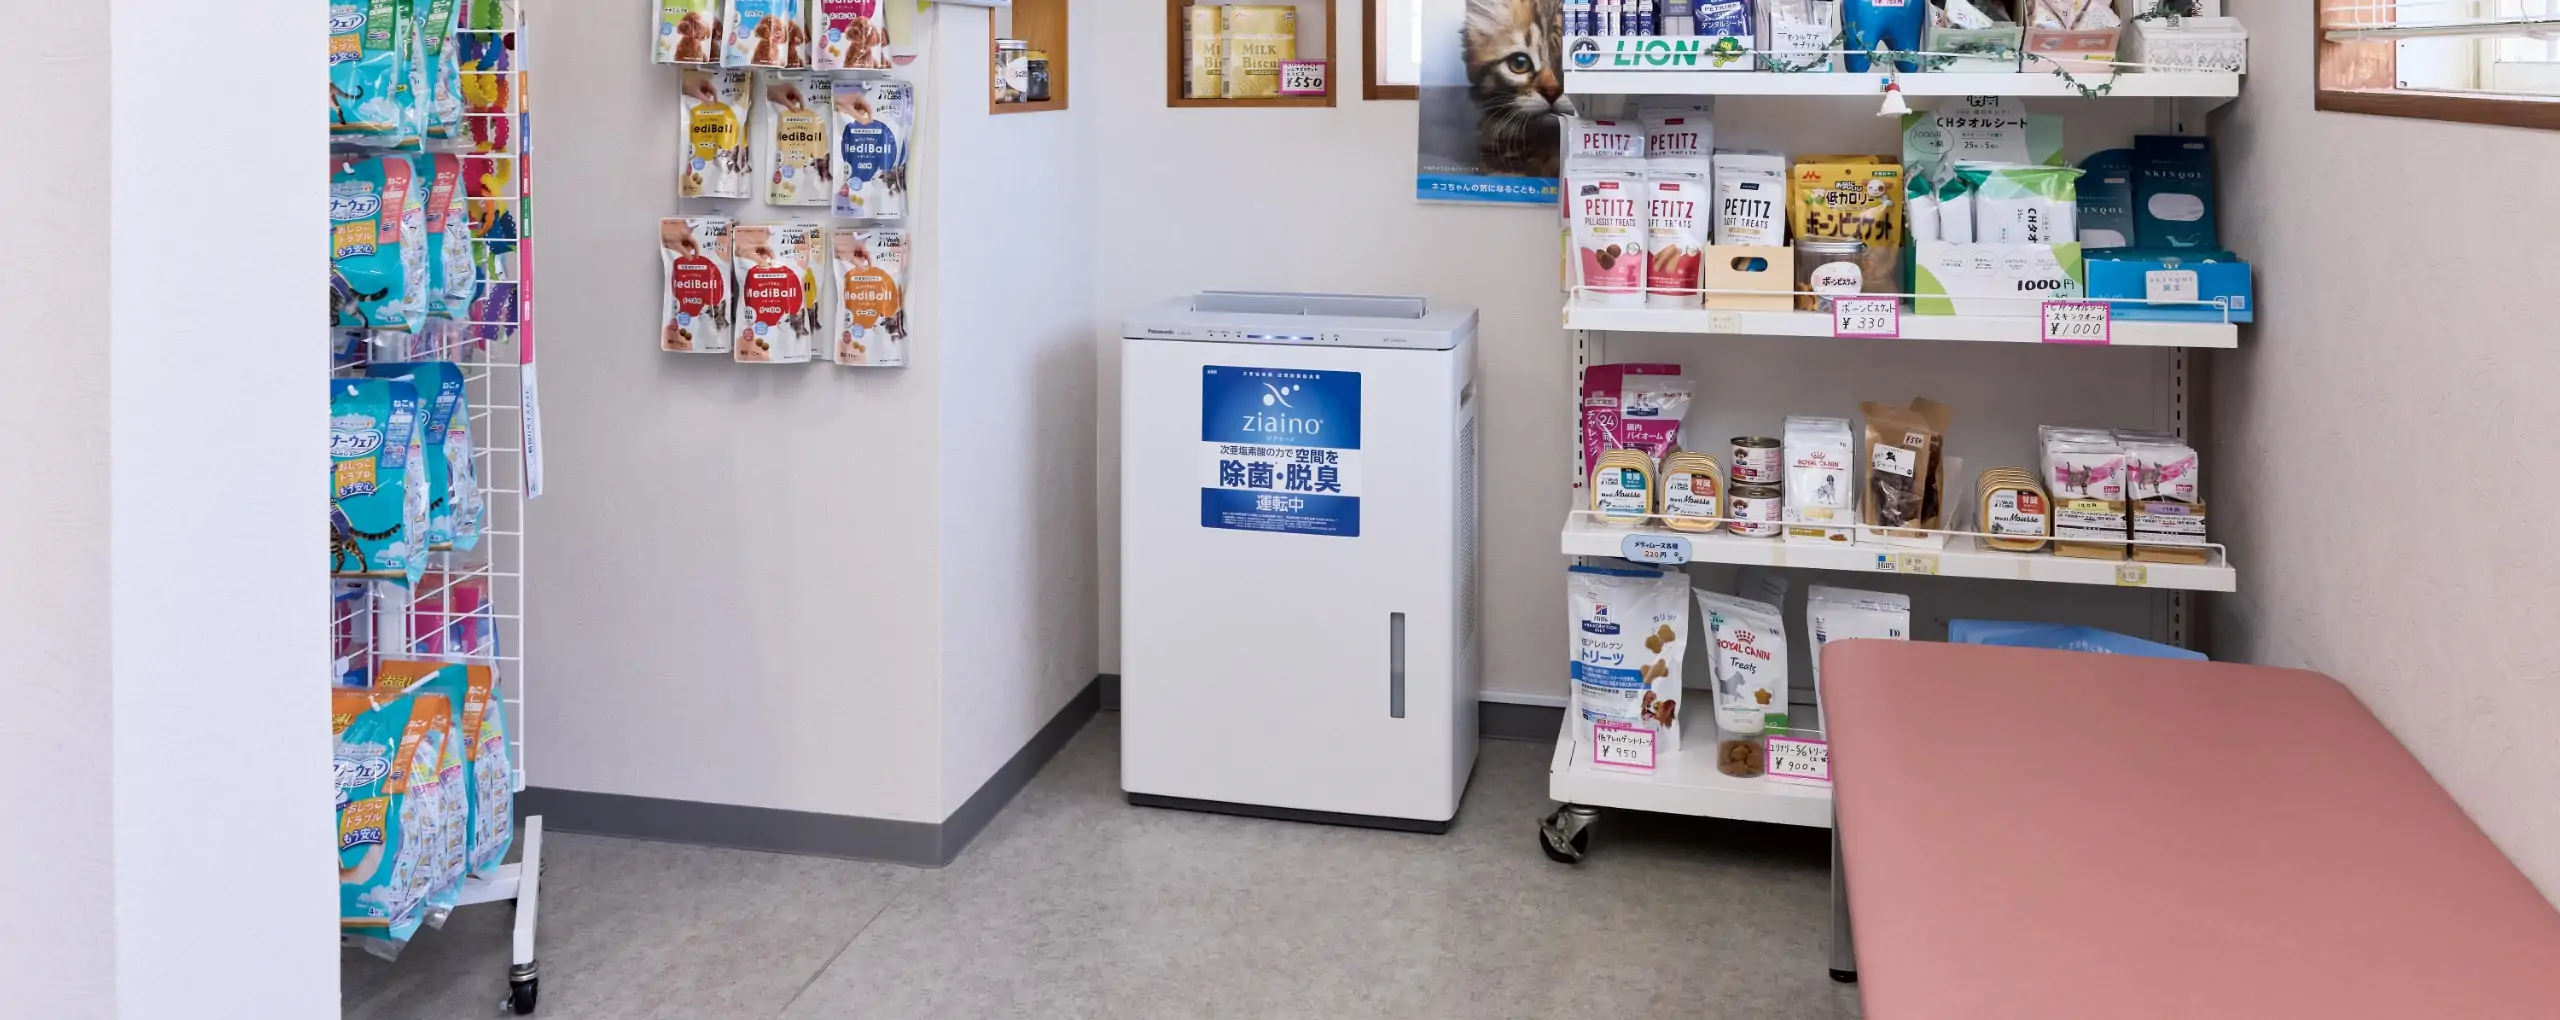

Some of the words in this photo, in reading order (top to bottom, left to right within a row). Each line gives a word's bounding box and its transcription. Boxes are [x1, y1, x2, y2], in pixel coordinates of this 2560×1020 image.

[1701, 20, 1743, 30] デンタルシート
[1613, 40, 1700, 66] LION
[1286, 76, 1323, 88] ¥550
[691, 124, 733, 134] ediBall
[1936, 117, 2028, 129] CHタオルシート
[1583, 133, 1631, 150] PETITZ
[1650, 132, 1698, 150] PETITZ
[2144, 170, 2204, 180] SKINQOL
[1826, 192, 1875, 206] 低カロリー
[1585, 199, 1635, 217] PETITZ
[1724, 198, 1772, 219] PETITZ
[1585, 217, 1596, 227] PILL
[1595, 217, 1614, 227] ASSIST
[1615, 218, 1636, 227] TREATS
[1664, 219, 1692, 229] TREATS
[1723, 217, 1737, 227] SOFT
[1740, 218, 1769, 229] TREATS
[1806, 211, 1893, 240] ボーンビスケット
[339, 234, 372, 243] トラブル
[1822, 276, 1858, 287] ボーンビスケット
[2017, 278, 2075, 292] 1000円
[1841, 301, 1895, 314] ボーンビスケット
[1842, 316, 1886, 330] ¥330
[2050, 322, 2102, 335] ¥1000
[1242, 411, 1320, 436] ziaino
[1626, 423, 1643, 432] 腸内
[1586, 410, 1599, 457] チャレンジ
[1626, 432, 1664, 441] バイオーム
[1905, 435, 1923, 445] ¥550
[332, 434, 378, 448] ナーウェア
[1219, 444, 1295, 459] 次亜塩素酸の力で
[1294, 448, 1340, 465] 空間を
[339, 459, 372, 471] おしっこ
[1819, 460, 1840, 468] CANIN
[339, 471, 372, 483] トラブル
[1219, 459, 1342, 494] 除菌・脱臭
[340, 482, 374, 496] もう安心
[1613, 489, 1641, 499] Mousse
[1255, 494, 1305, 513] 運転中
[1683, 495, 1711, 506] Mousse
[2008, 512, 2039, 524] Mousse
[1644, 550, 1668, 559] 220円
[1716, 637, 1744, 654] ROYAL
[1744, 644, 1772, 661] CANIN
[1581, 647, 1625, 666] トリーツ
[1729, 656, 1758, 675] Treats
[1598, 733, 1653, 746] 低アレルゲントリーツ
[1602, 745, 1637, 759] ¥950
[348, 800, 384, 815] おしっこ
[346, 814, 383, 827] トラブル
[343, 827, 382, 845] もう安心
